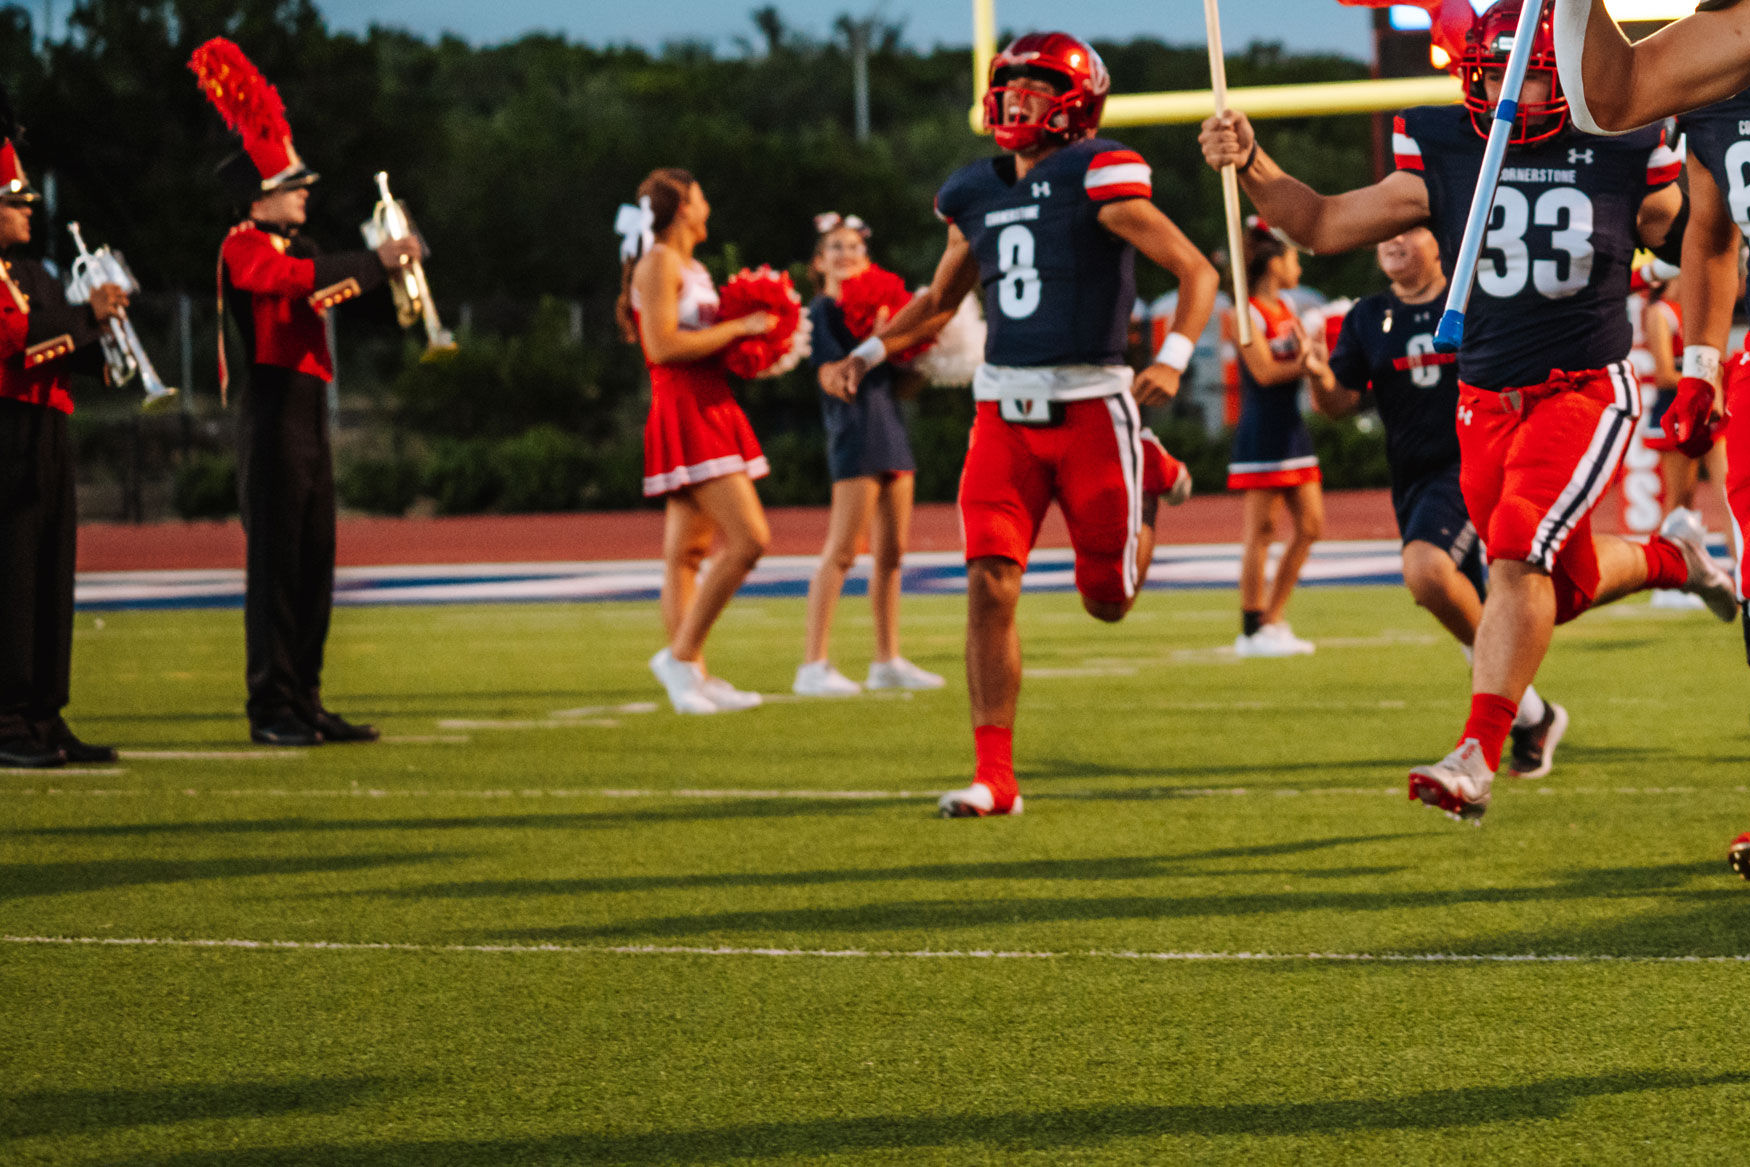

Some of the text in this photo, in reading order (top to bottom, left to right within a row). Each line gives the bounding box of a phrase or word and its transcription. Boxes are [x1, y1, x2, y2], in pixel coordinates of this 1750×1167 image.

[1500, 167, 1577, 184] ORNERSTONE
[998, 224, 1041, 320] 8
[1477, 185, 1595, 300] 33
